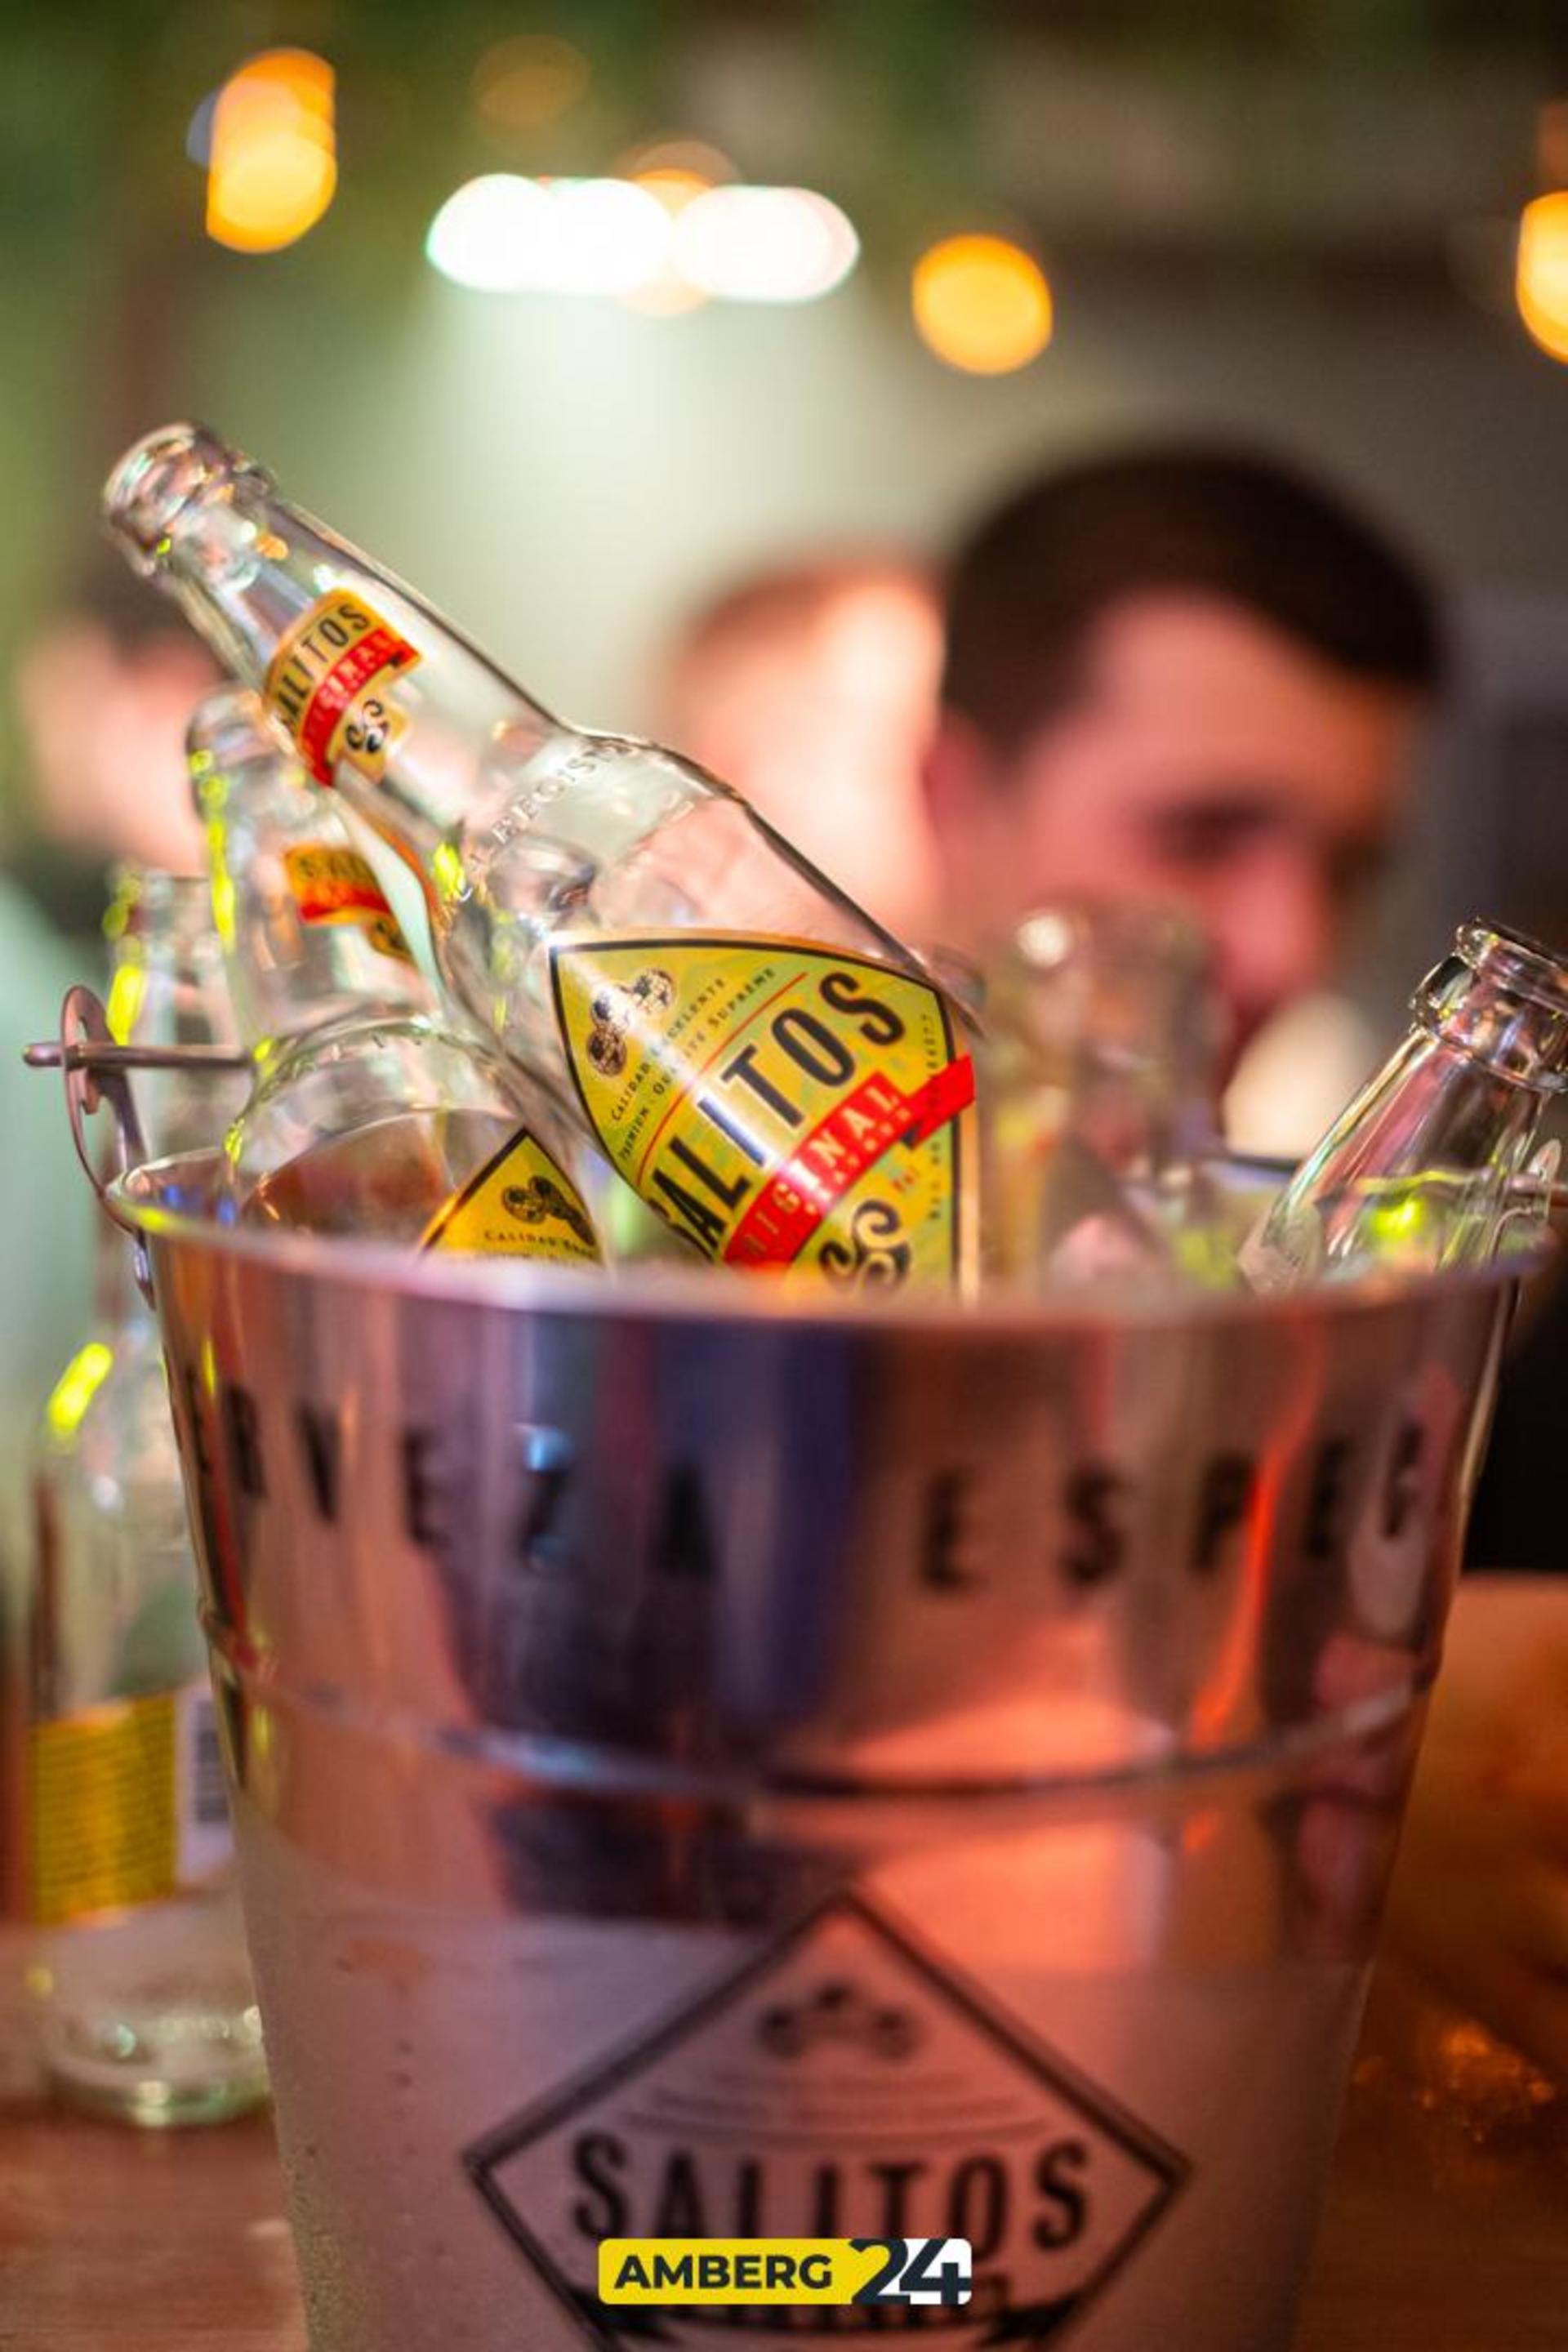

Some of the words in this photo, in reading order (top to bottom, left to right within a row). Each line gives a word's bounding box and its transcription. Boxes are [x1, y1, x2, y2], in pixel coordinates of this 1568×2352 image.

[278, 604, 370, 731] ALITOS
[611, 1062, 652, 1121] CALIDAD
[651, 978, 726, 1055] ECELENTE
[745, 1085, 899, 1256] IGINAL
[189, 1376, 720, 1581] RVEZA
